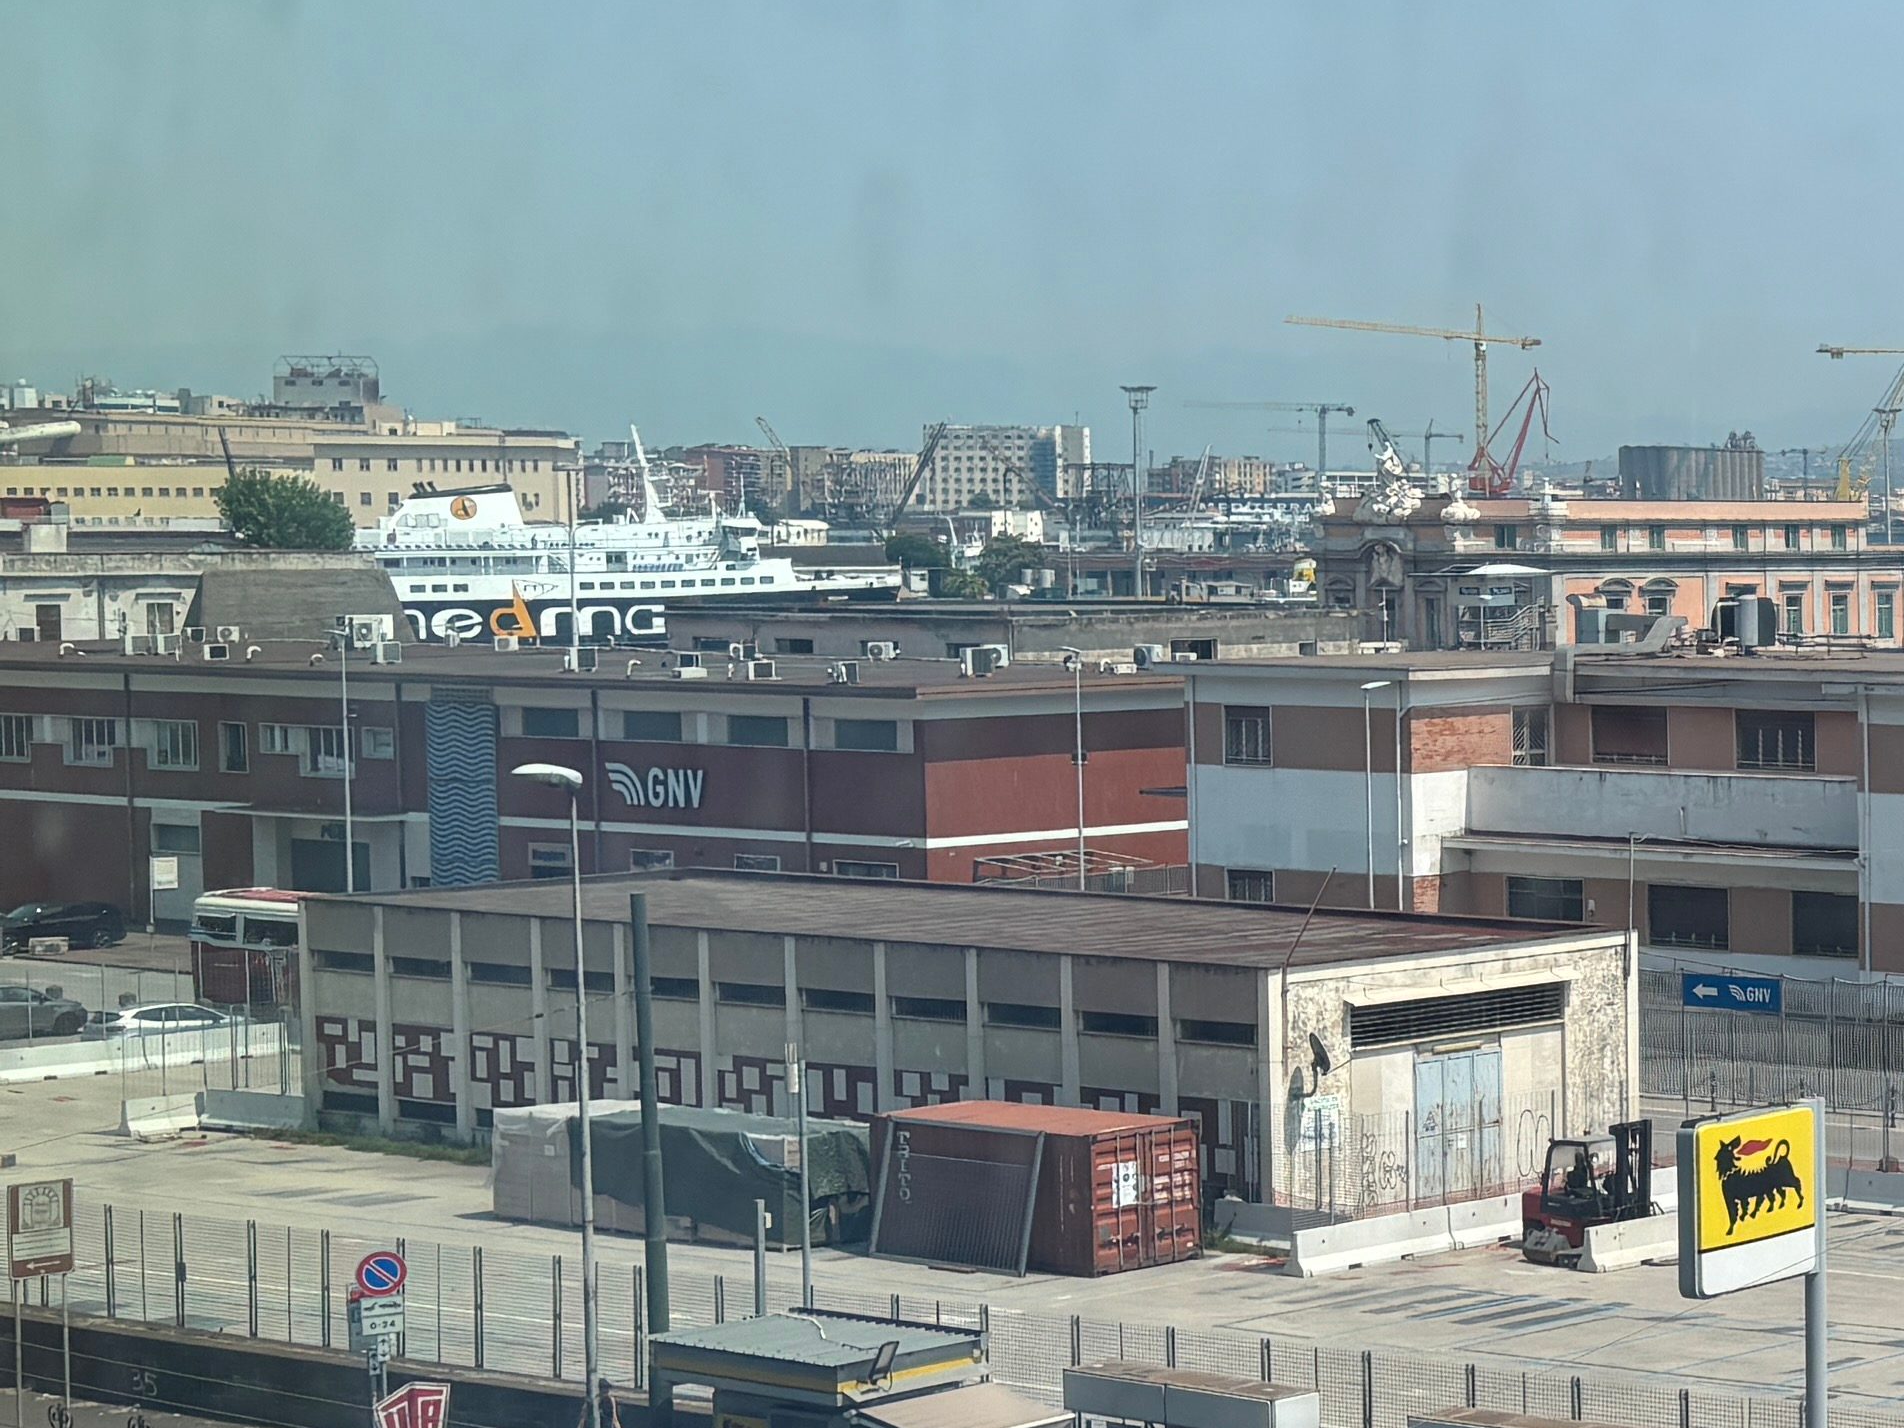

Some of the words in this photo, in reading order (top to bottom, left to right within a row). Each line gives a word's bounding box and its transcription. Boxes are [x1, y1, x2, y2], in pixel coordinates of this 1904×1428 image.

[647, 766, 704, 809] GNV
[1746, 986, 1771, 1004] GNV
[132, 1369, 158, 1396] 35
